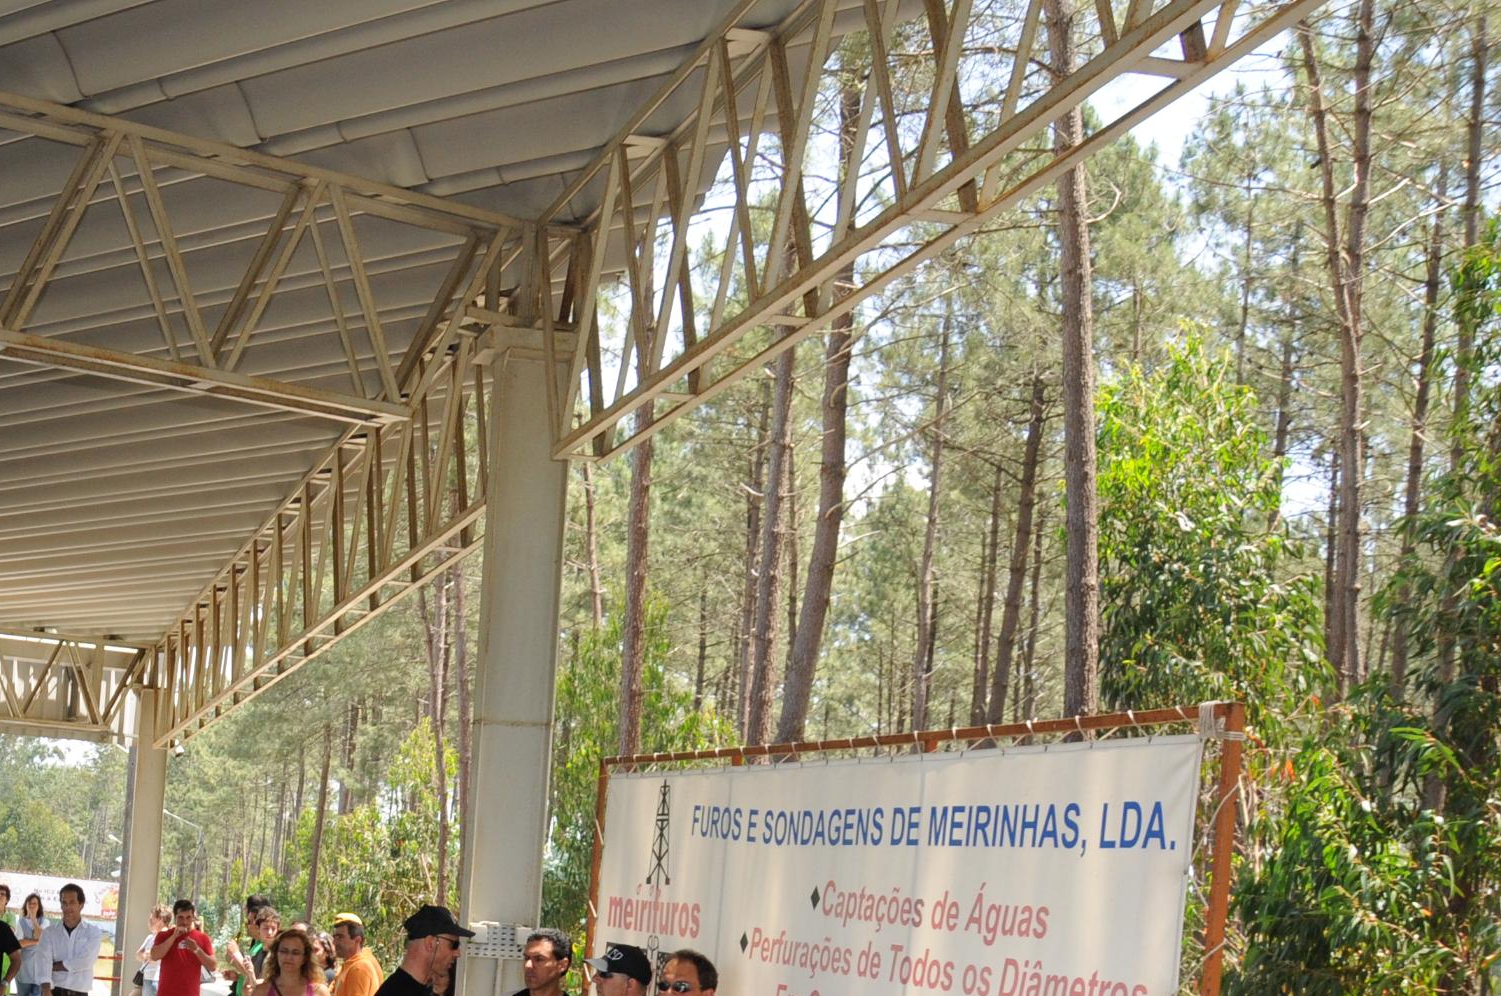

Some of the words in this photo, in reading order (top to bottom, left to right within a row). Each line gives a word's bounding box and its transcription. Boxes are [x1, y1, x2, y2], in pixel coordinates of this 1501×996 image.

[691, 804, 743, 841] FUROS
[746, 808, 759, 843] E
[762, 807, 885, 846] SONDAGENS
[890, 806, 921, 847] DE
[927, 802, 1087, 857] MEIRINHAS,
[1099, 801, 1176, 850] LDA.
[822, 879, 925, 932] Captações
[931, 890, 960, 932] de
[964, 882, 1050, 946] Águas
[749, 927, 853, 979] Perfurações
[857, 941, 881, 979] de
[889, 944, 955, 991] Todos
